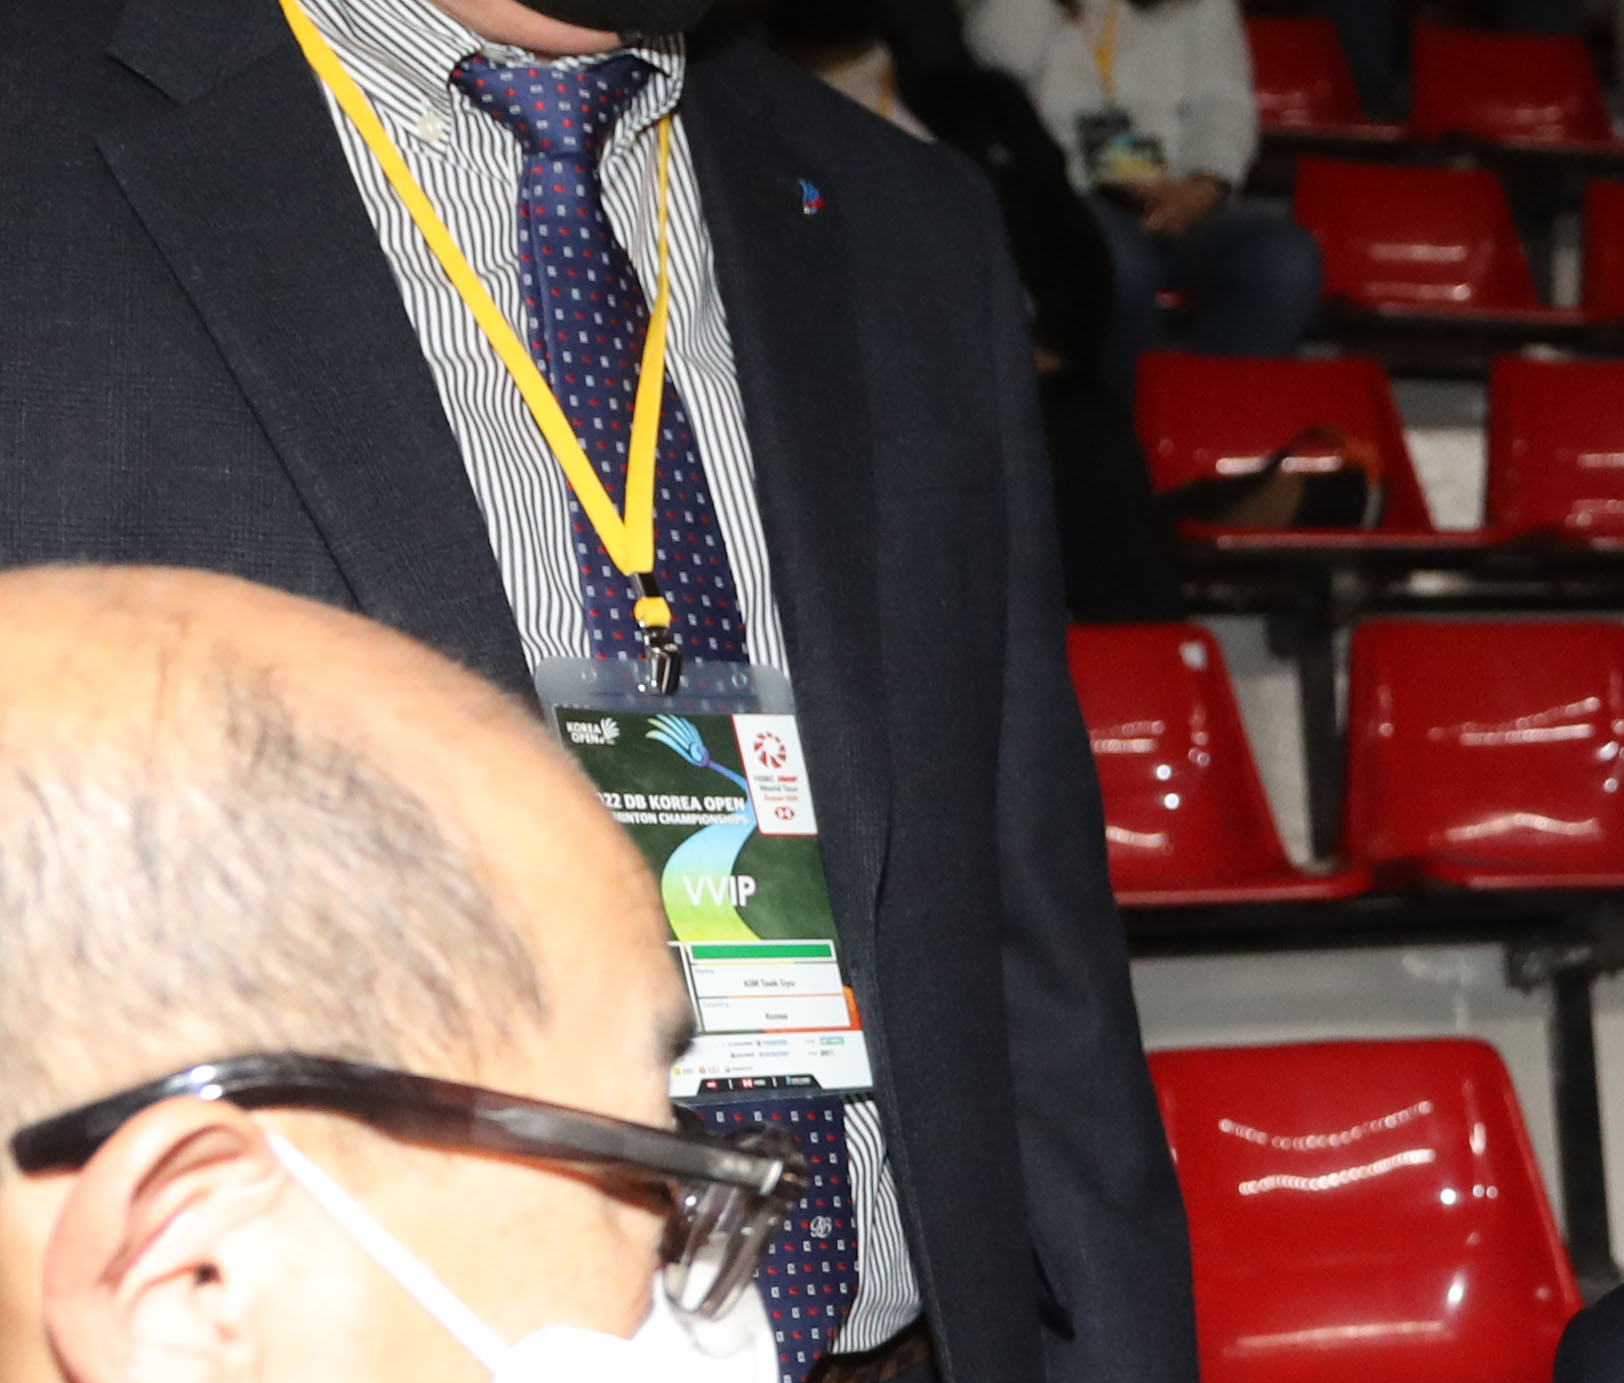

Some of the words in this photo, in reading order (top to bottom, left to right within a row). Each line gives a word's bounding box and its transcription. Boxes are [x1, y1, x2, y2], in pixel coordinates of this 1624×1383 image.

[623, 793, 647, 810] DB
[649, 794, 703, 811] KOREA
[703, 796, 747, 811] OPEN
[658, 812, 750, 825] CHAMPIONSHIPS
[682, 875, 757, 907] VVIP
